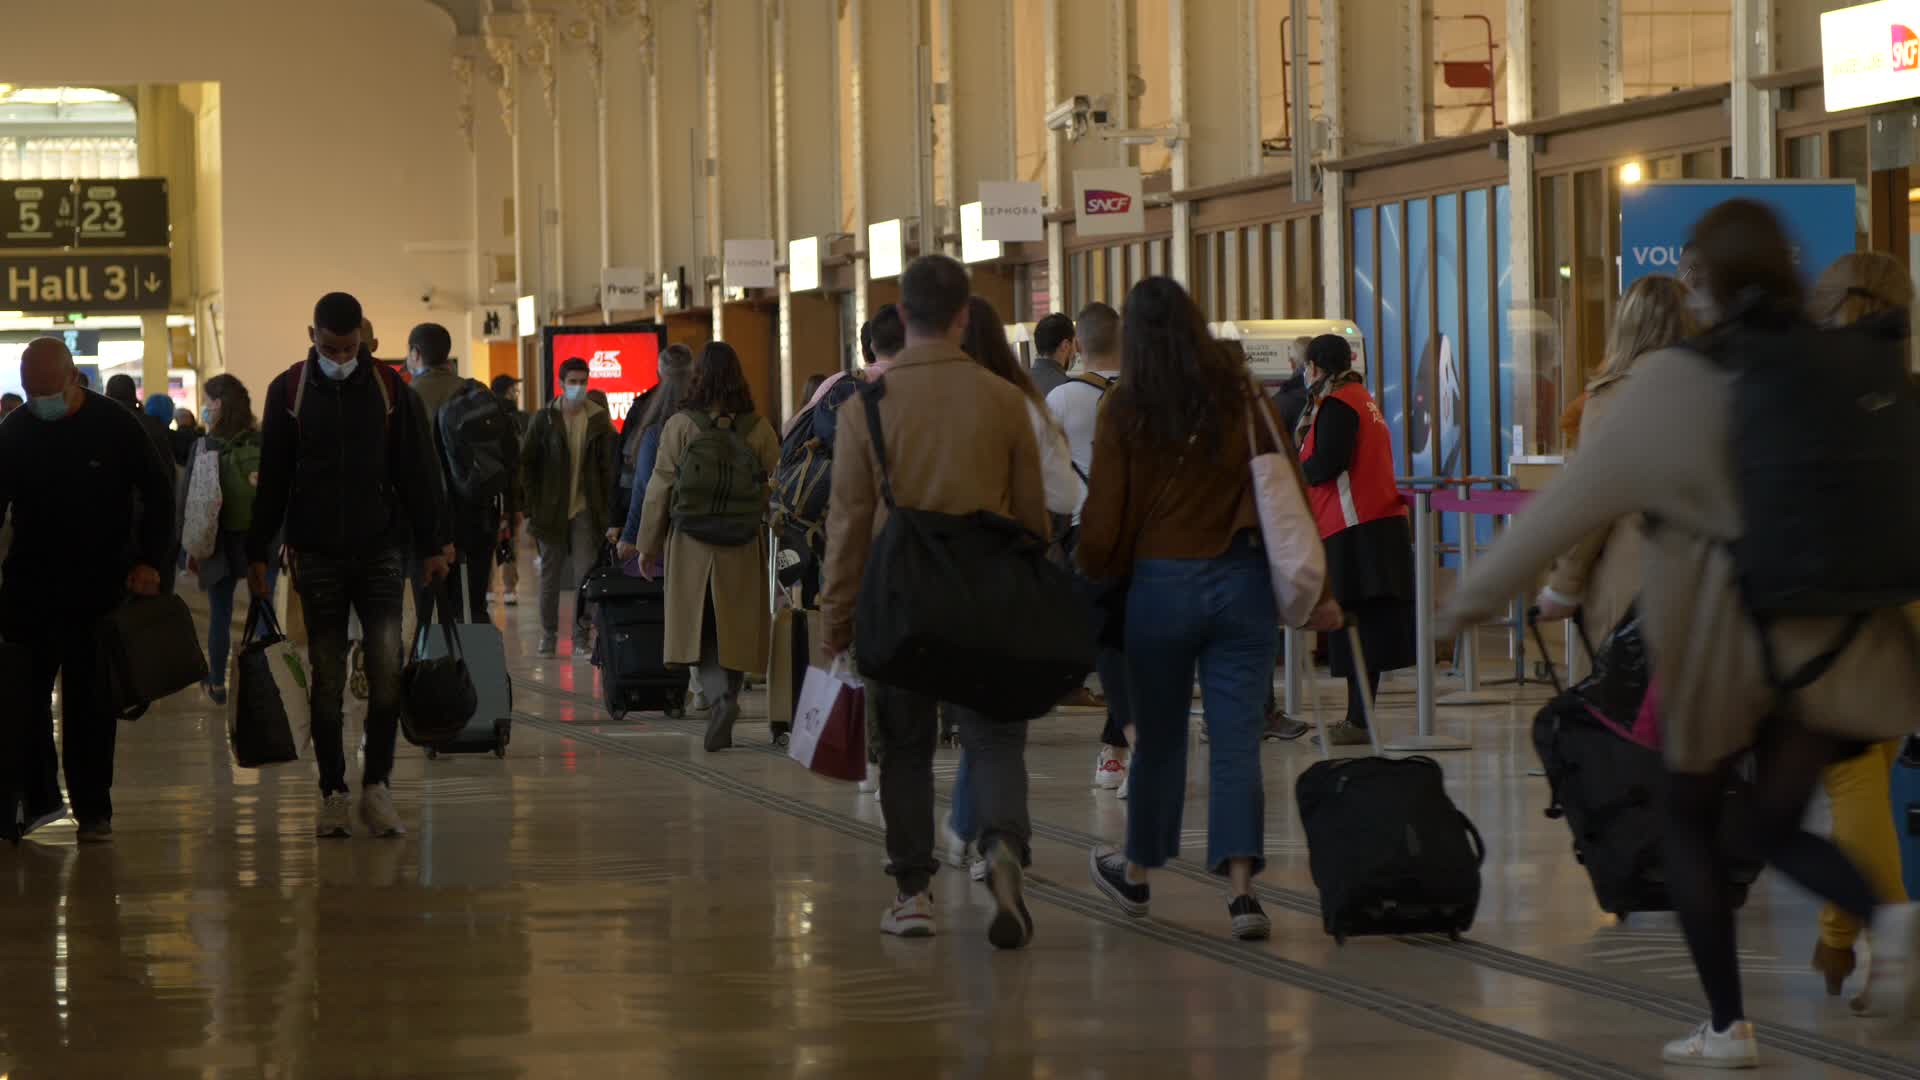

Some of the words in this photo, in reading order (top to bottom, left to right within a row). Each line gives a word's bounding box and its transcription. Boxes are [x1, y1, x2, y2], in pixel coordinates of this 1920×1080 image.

[1893, 37, 1919, 70] SNCF
[19, 201, 41, 233] 5
[82, 200, 124, 232] 23
[1087, 197, 1129, 213] SNCF
[8, 265, 93, 302] Hall
[103, 264, 128, 302] 3
